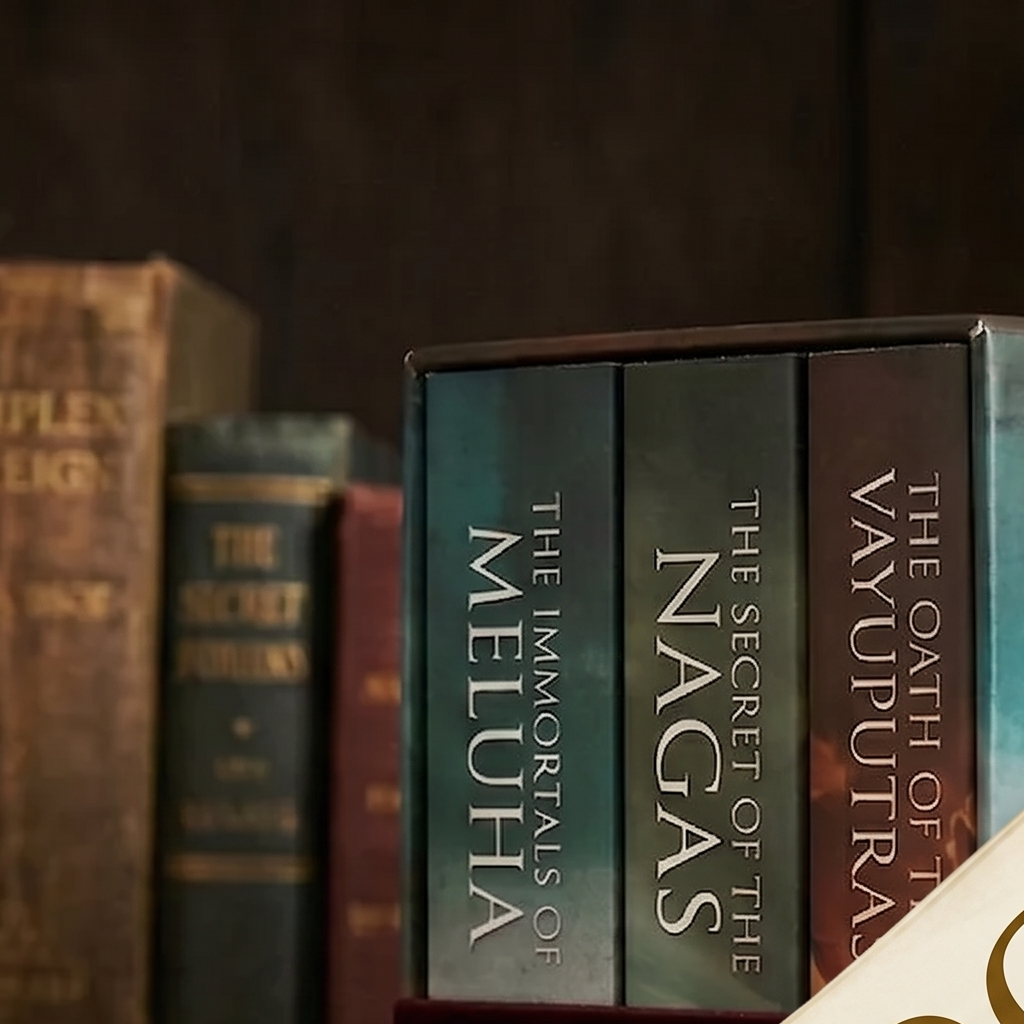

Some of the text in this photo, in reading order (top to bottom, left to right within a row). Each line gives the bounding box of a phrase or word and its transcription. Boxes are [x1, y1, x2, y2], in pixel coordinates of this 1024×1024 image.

[907, 472, 941, 579] THE
[908, 600, 942, 750] OATH
[467, 526, 525, 946] MELUHA
[531, 492, 561, 965] THE IMMORTALS OF
[655, 547, 724, 935] NAGAS
[730, 488, 761, 973] THE SECRET OF THE
[907, 771, 942, 840] OF
